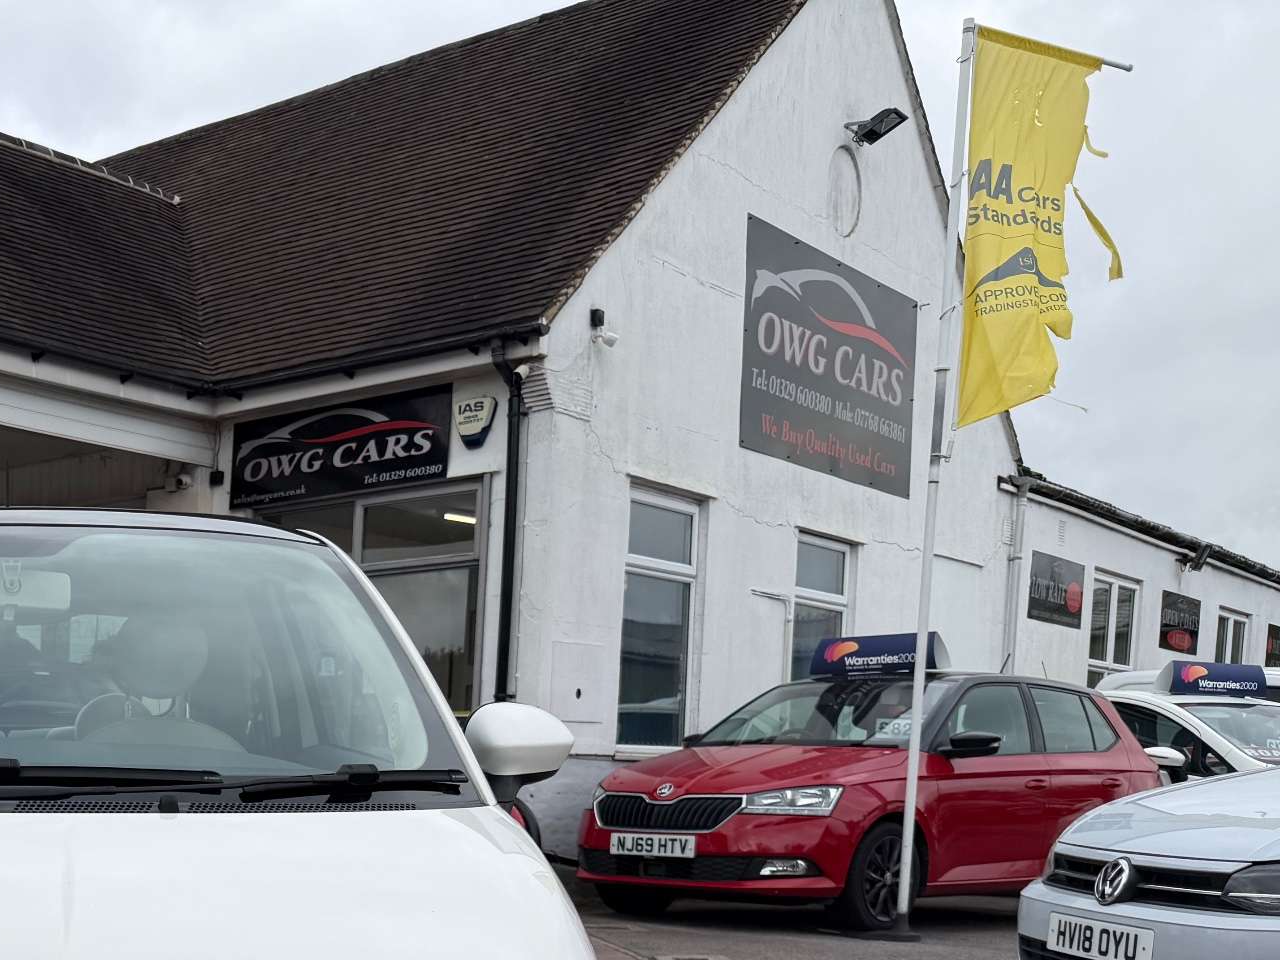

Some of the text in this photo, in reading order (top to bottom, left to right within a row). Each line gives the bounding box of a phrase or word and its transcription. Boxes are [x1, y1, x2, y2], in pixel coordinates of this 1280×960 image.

[970, 158, 1013, 204] AA
[757, 311, 904, 406] OWG CARS
[458, 401, 485, 415] IAS
[751, 367, 768, 390] Tel:
[769, 375, 796, 402] 01329
[797, 386, 832, 415] 600380
[245, 429, 433, 482] OWG CARS
[761, 414, 896, 477] We Buy Quality Used Cars
[364, 464, 443, 484] Tel: 01329 600380
[844, 653, 918, 665] Warranties200
[1198, 680, 1258, 690] Warranties2000
[616, 836, 689, 855] NJ69 HTV
[1056, 919, 1094, 953] HV18
